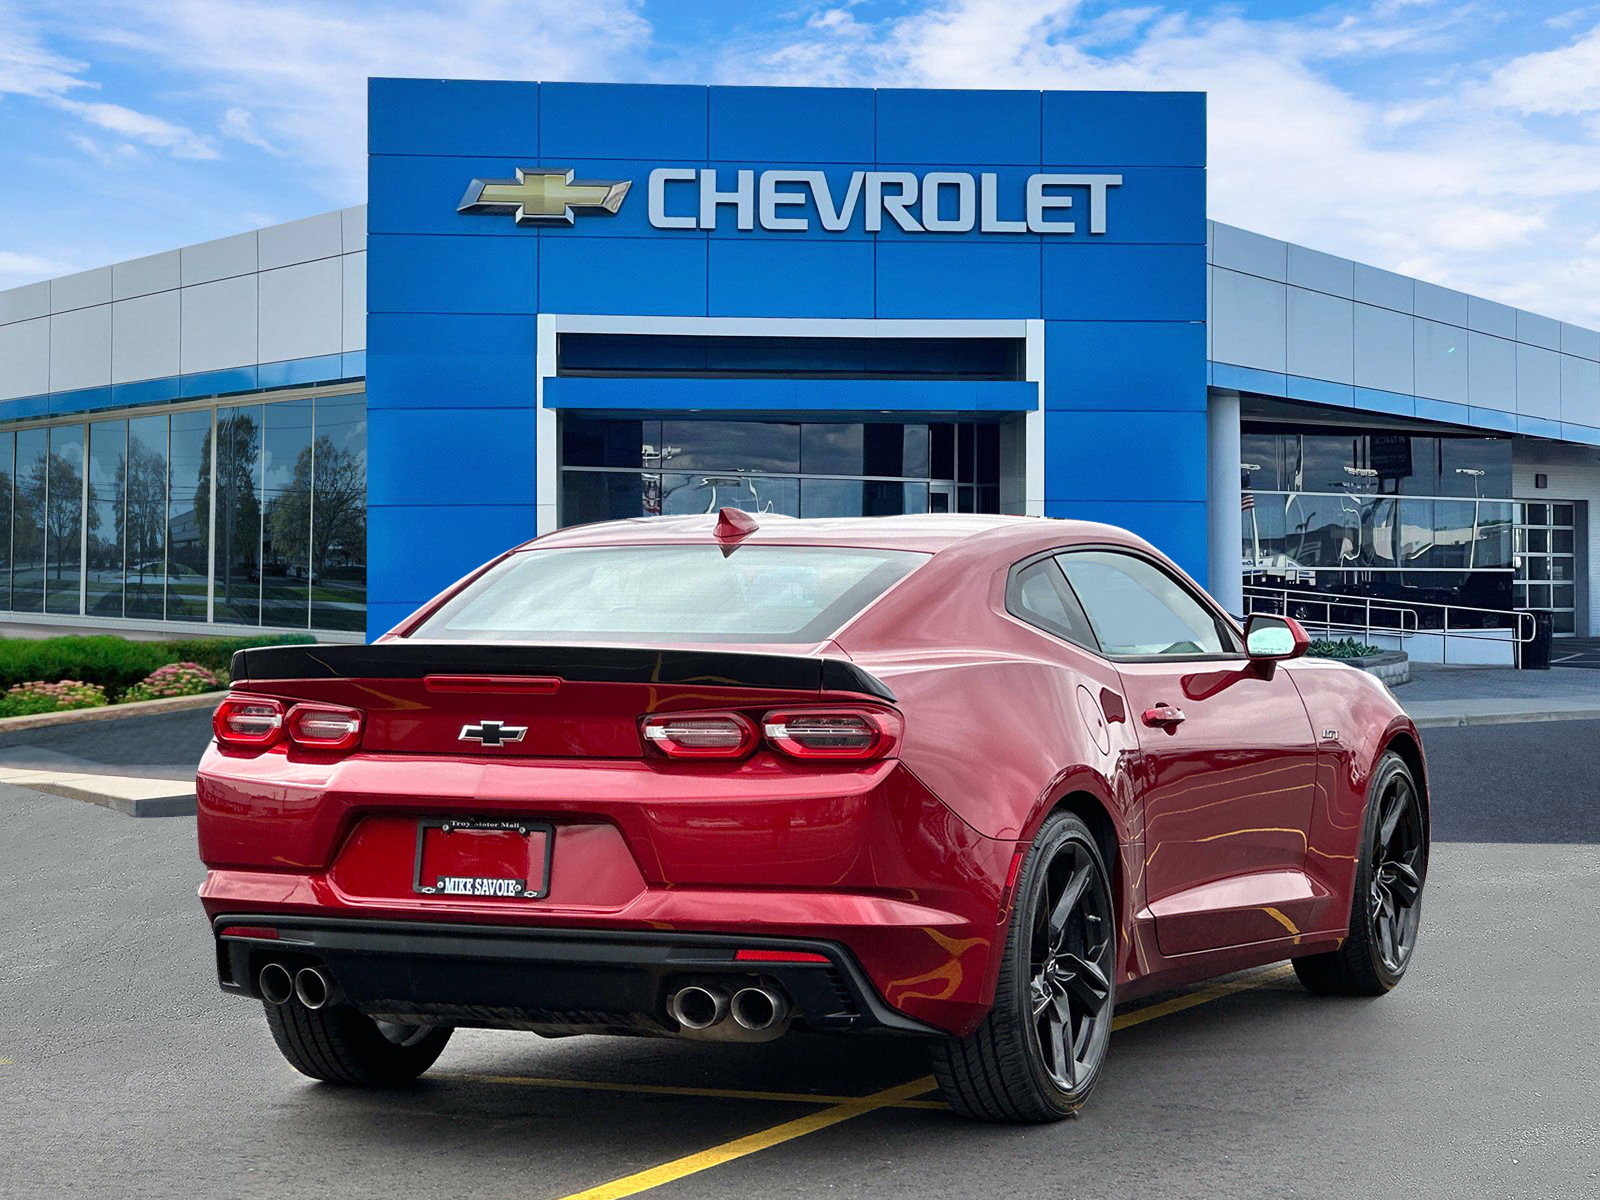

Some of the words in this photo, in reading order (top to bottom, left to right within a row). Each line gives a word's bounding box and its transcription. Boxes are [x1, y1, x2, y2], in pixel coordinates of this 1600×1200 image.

[647, 167, 1123, 235] CHEVROLET
[450, 820, 470, 828] Troy
[444, 877, 474, 895] MIKE
[474, 878, 516, 896] SAVOIE
